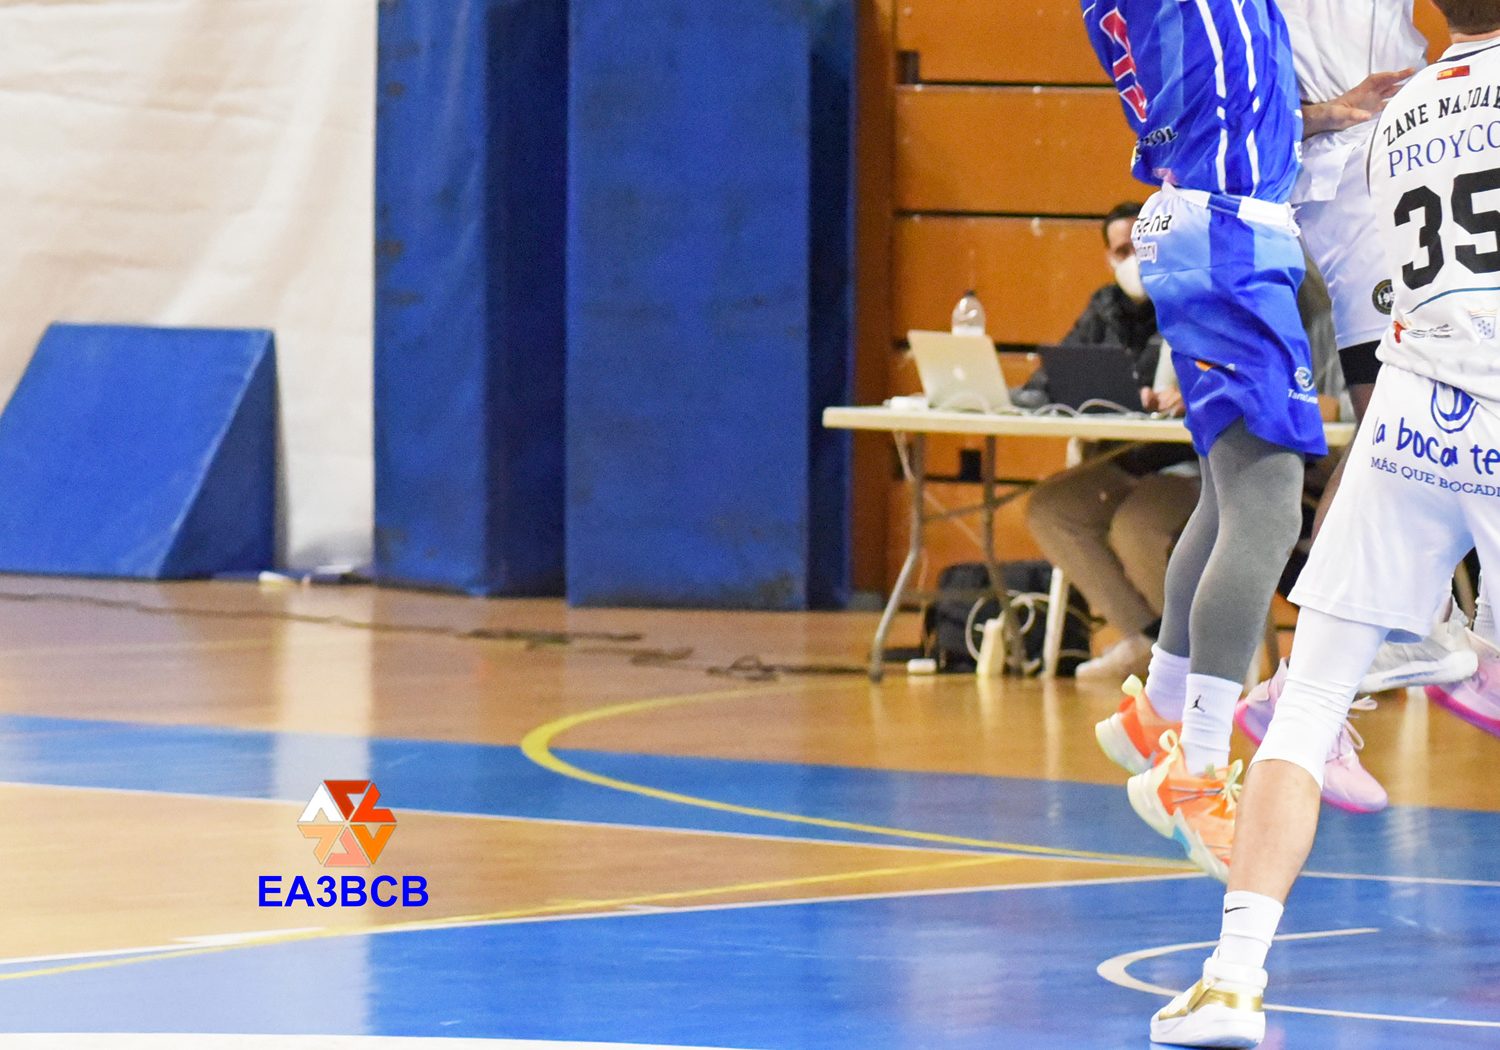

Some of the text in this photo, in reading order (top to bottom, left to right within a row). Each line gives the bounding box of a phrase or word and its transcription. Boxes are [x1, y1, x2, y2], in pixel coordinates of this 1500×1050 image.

[1382, 103, 1429, 147] ZANE
[1372, 416, 1386, 446] la
[1396, 417, 1459, 467] boca
[1370, 456, 1398, 474] MÁS
[1401, 465, 1435, 485] QUE
